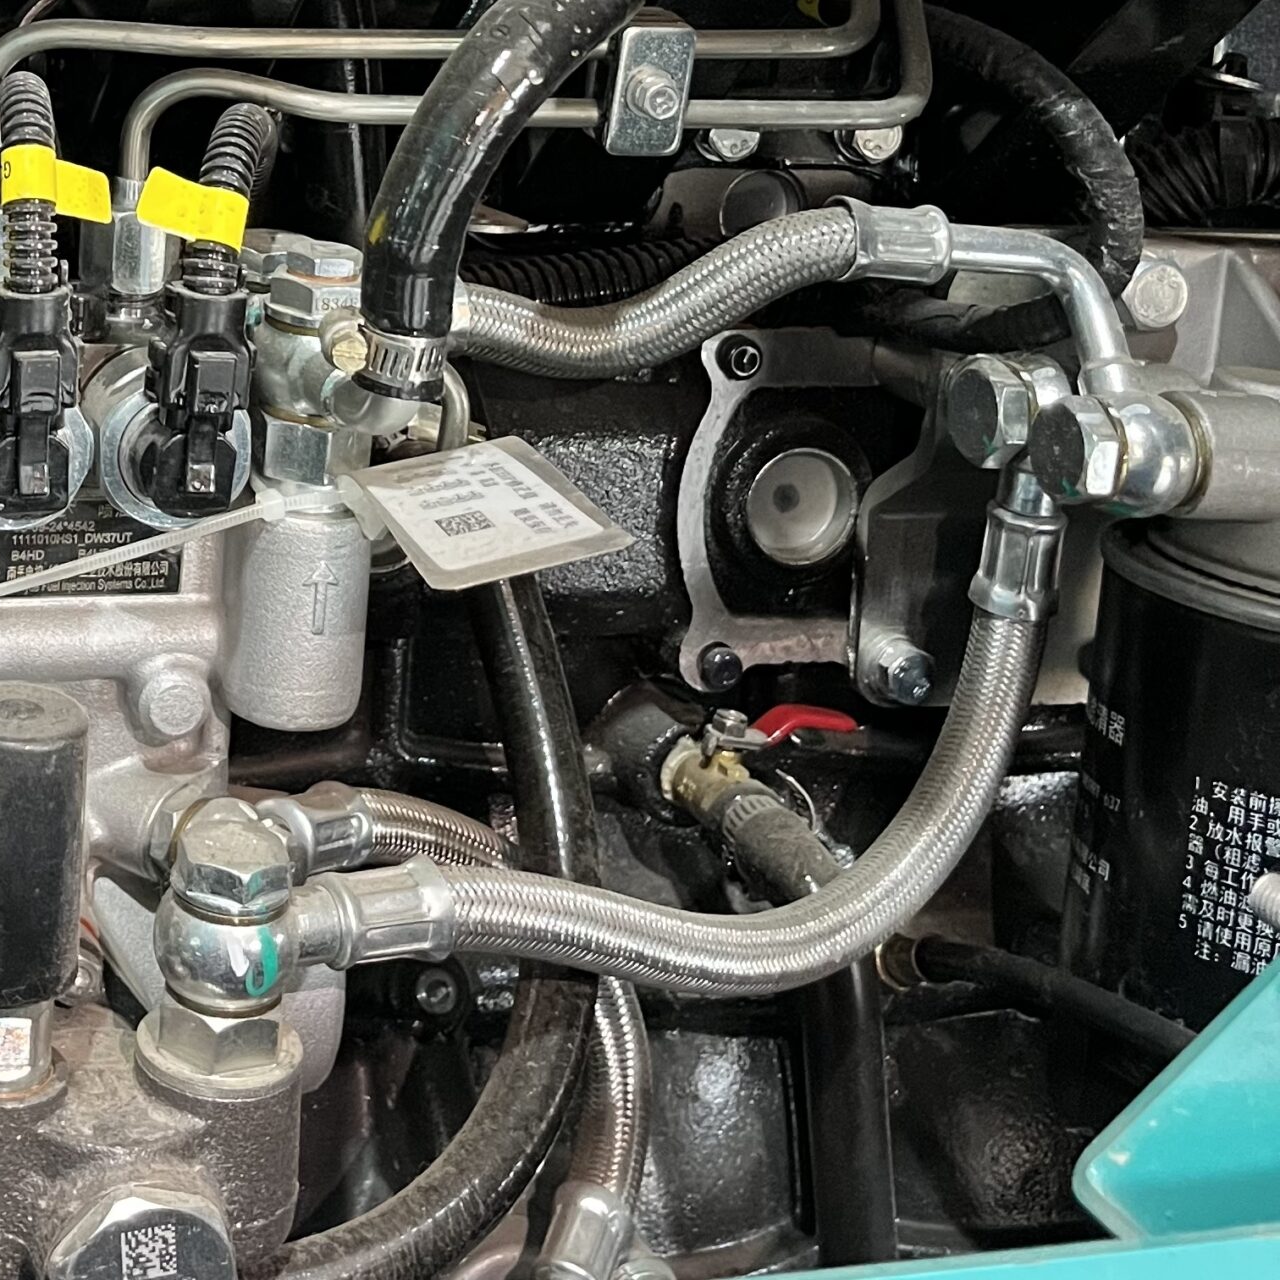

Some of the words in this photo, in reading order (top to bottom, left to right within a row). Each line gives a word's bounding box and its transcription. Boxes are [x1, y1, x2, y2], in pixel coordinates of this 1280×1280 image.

[11, 549, 45, 561] B4HD
[98, 578, 133, 591] Systems
[1189, 814, 1198, 831] 2
[1185, 855, 1194, 871] 3
[1182, 875, 1192, 889] 4
[1178, 913, 1187, 929] 5
[1181, 892, 1280, 941] 需及时更换
